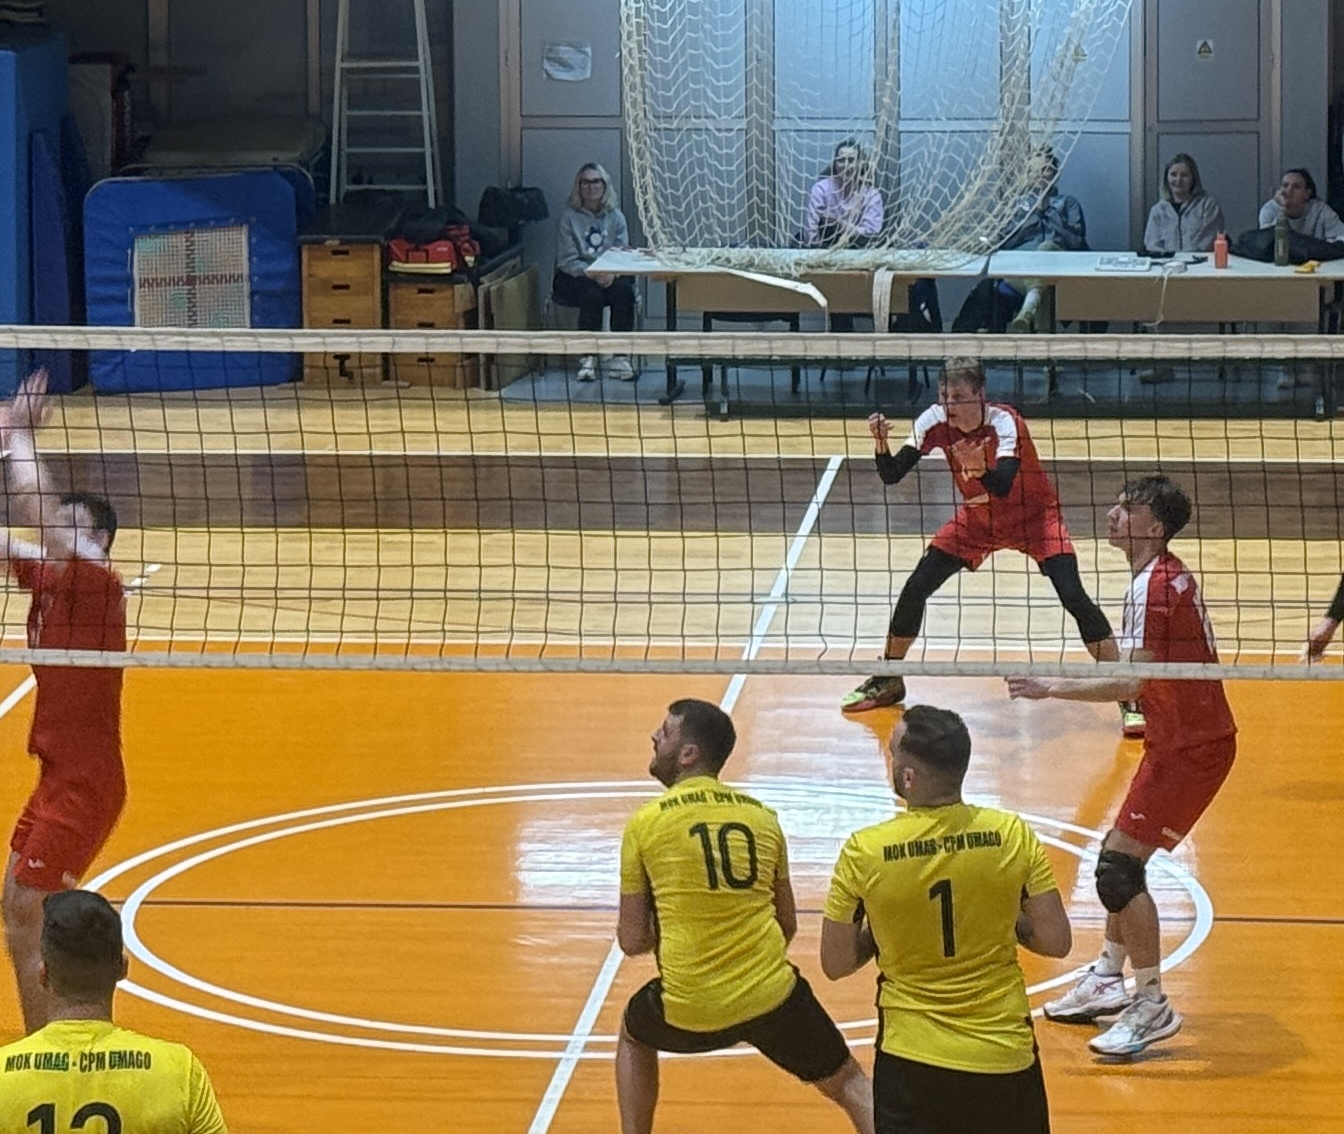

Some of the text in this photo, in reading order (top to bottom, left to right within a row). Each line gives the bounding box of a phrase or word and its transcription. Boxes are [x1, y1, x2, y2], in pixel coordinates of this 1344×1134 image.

[688, 821, 758, 890] 10
[884, 843, 907, 862] MOK
[929, 879, 956, 958] 1
[4, 1052, 33, 1073] MOK
[34, 1051, 70, 1072] UMAG
[79, 1051, 106, 1073] CPM
[108, 1050, 152, 1071] UMAGO
